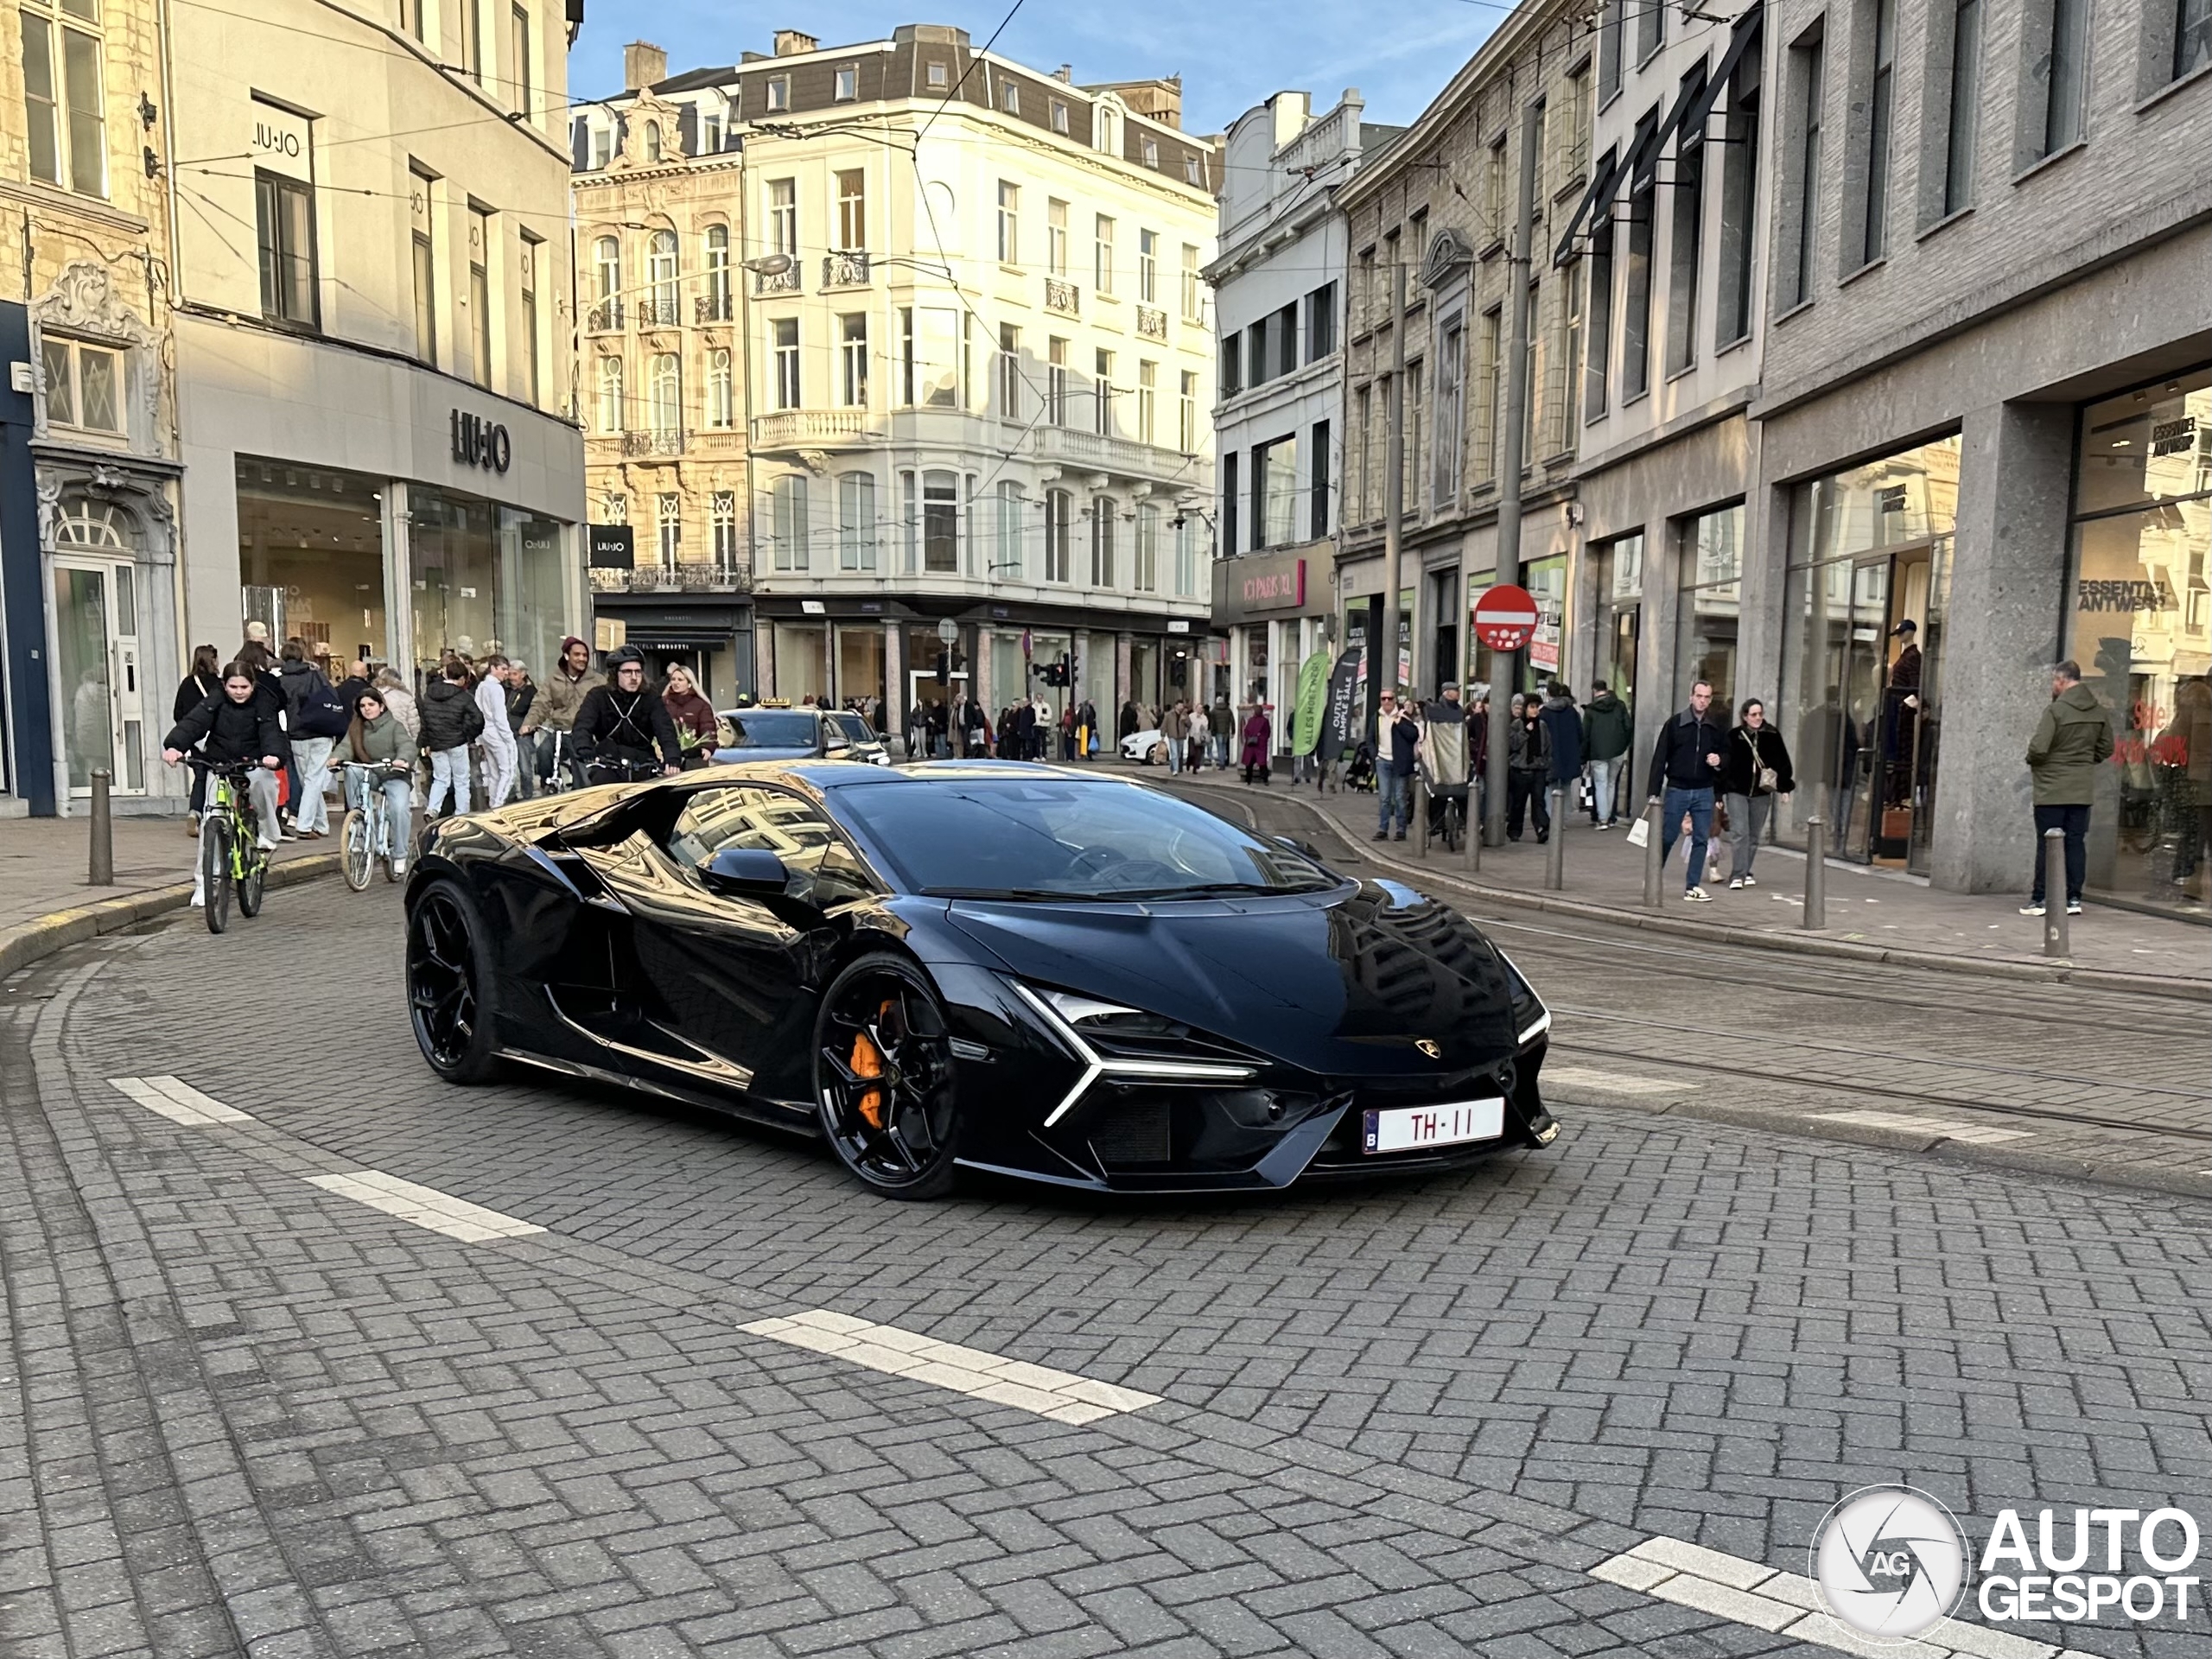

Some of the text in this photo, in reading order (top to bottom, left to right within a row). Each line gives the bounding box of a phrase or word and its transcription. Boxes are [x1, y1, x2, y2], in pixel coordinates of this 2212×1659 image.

[1255, 575, 1278, 601] PARIS
[1281, 573, 1292, 595] XL
[2078, 580, 2171, 596] ESSENTIEL
[2078, 594, 2165, 613] ANTWERP
[1332, 688, 1344, 728] OUTLET
[1338, 702, 1349, 742] SAMPLE
[1344, 676, 1352, 701] SALE
[2133, 699, 2166, 729] Sale
[1305, 716, 1313, 745] ALLES
[1366, 1134, 1376, 1147] B
